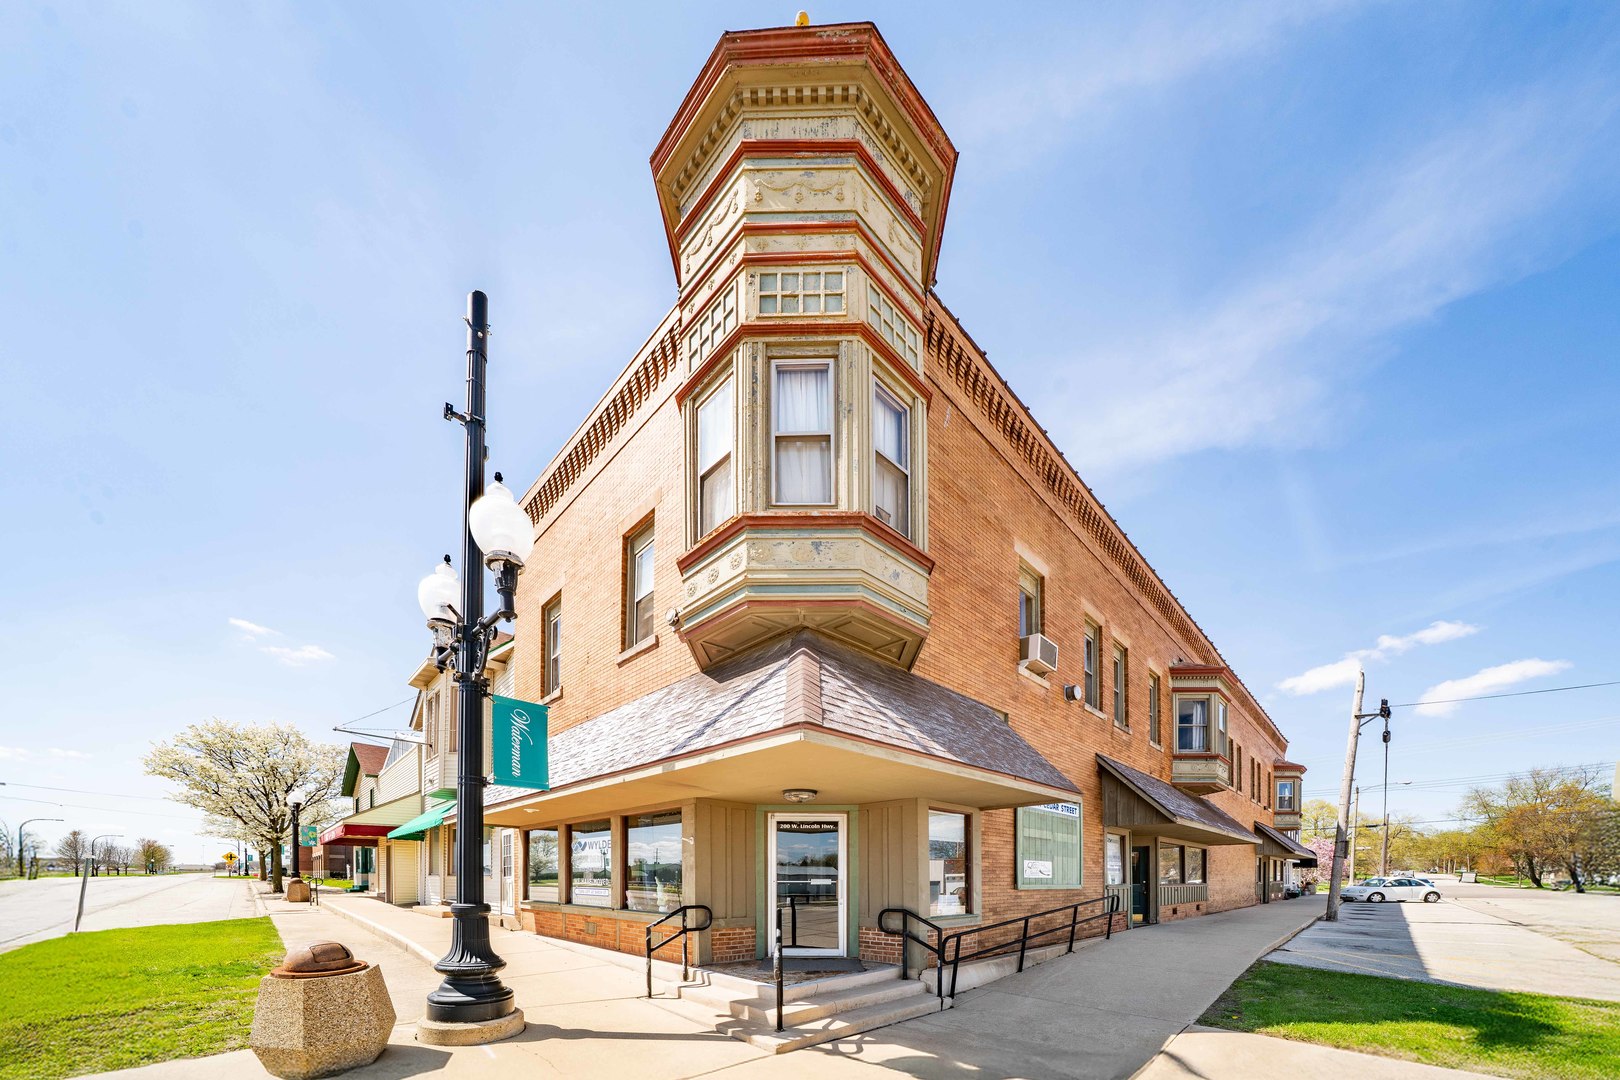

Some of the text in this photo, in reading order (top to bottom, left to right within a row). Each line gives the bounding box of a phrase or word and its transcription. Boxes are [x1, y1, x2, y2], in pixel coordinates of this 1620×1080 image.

[510, 709, 533, 777] Waterman
[1060, 804, 1077, 814] STREET
[588, 840, 611, 850] WYLDE
